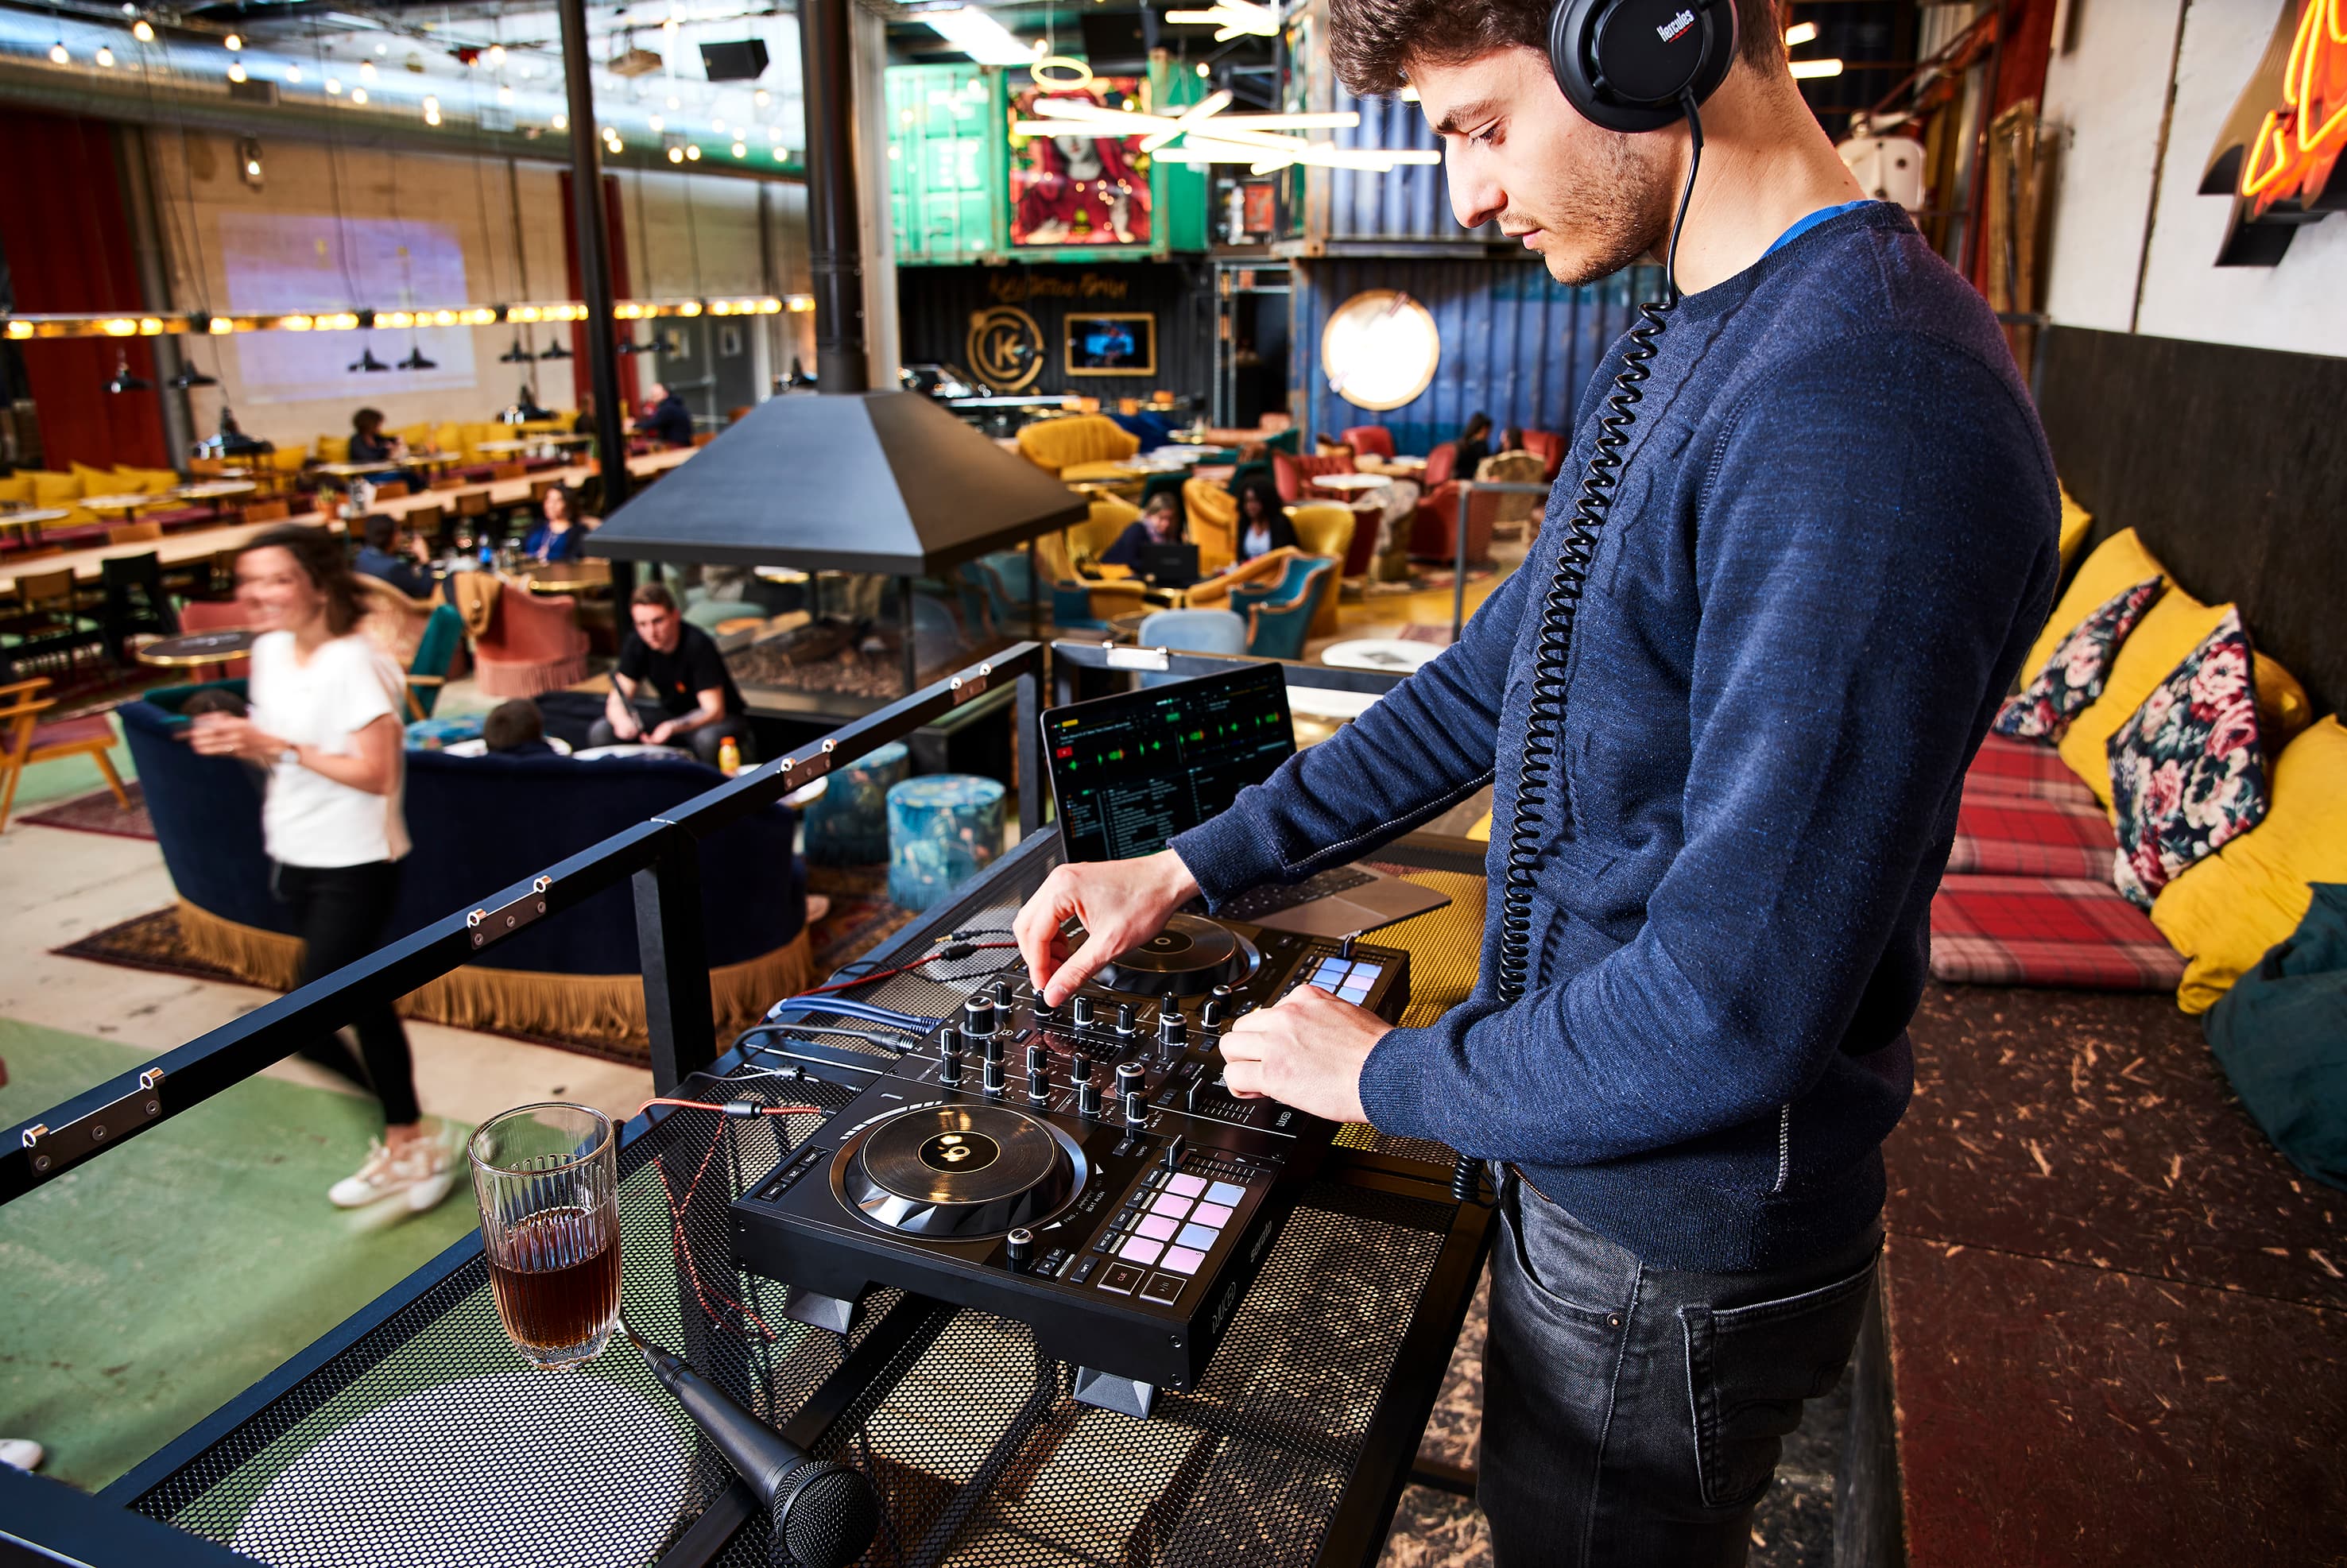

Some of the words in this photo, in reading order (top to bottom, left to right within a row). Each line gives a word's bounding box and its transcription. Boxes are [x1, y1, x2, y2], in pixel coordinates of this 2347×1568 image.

[1656, 10, 1694, 42] Hercules
[1136, 1145, 1148, 1158] TEMPO
[1117, 1214, 1126, 1222] LOOP
[1250, 1220, 1272, 1263] serato
[1117, 1272, 1128, 1281] CUE
[1212, 1281, 1236, 1334] DJUCED
